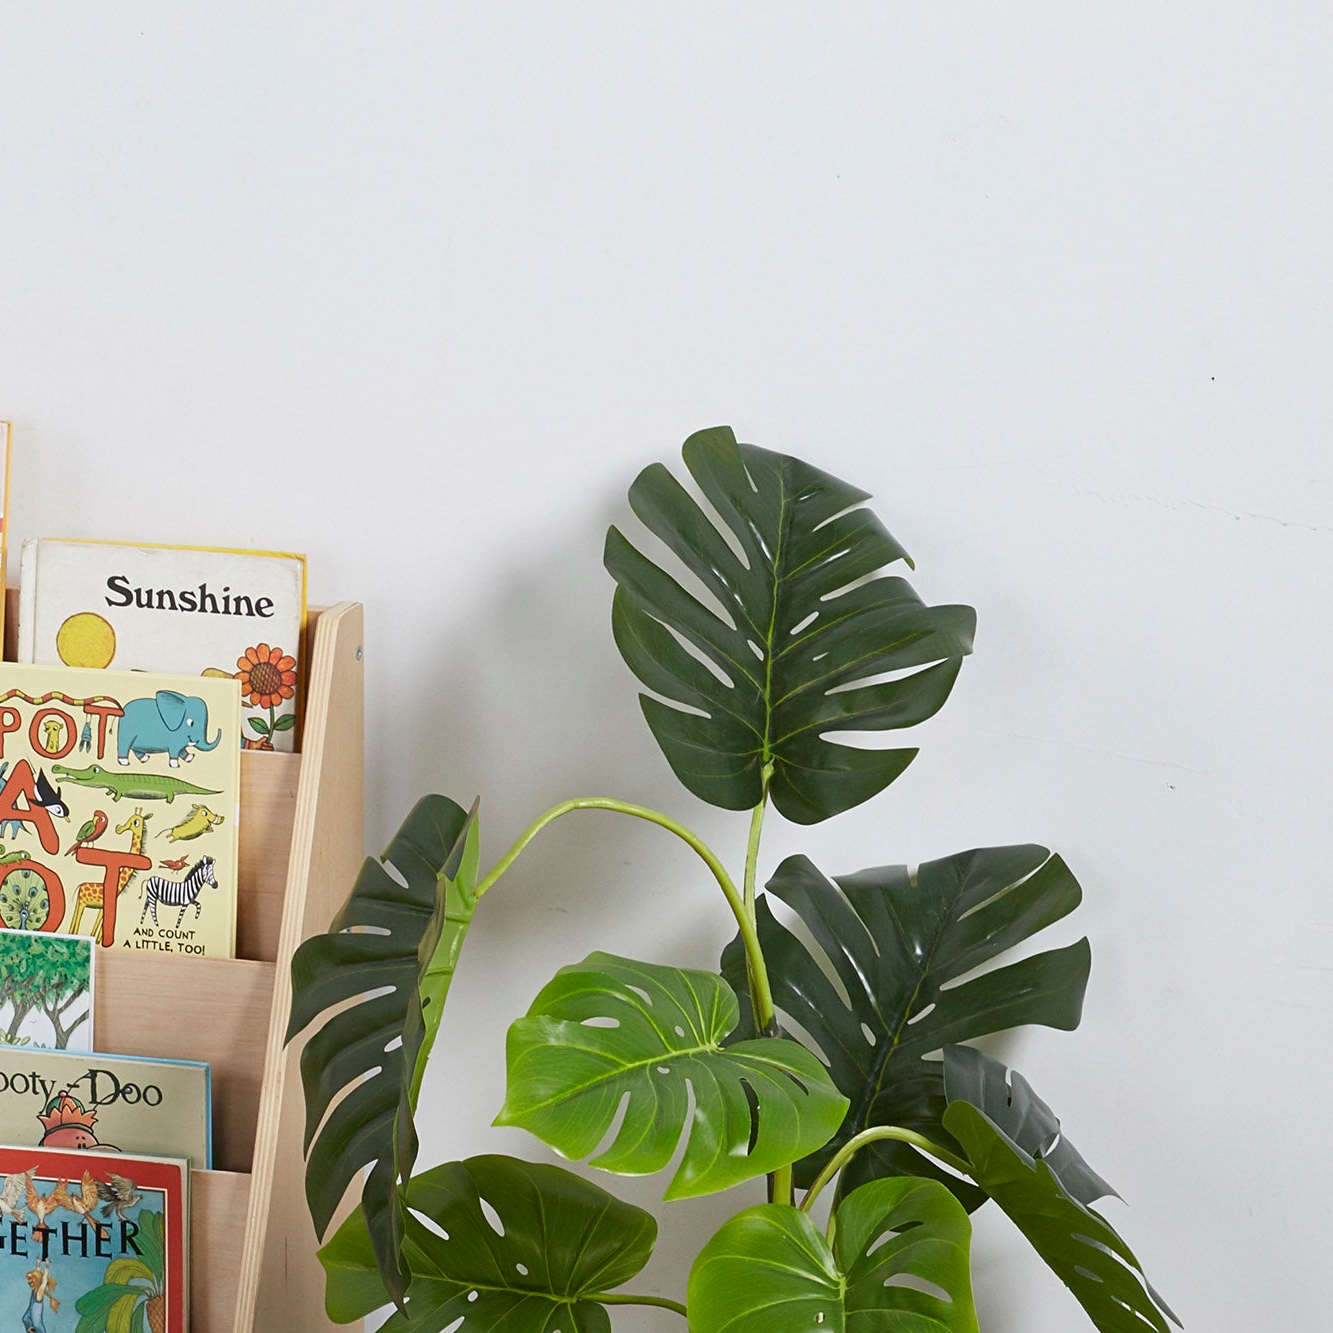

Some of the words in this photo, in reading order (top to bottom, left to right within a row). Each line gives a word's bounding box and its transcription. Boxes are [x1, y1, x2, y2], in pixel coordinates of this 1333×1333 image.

[105, 575, 275, 618] Sunshine
[133, 927, 154, 937] AND
[158, 929, 196, 940] COUNT
[123, 939, 131, 949] A
[135, 940, 173, 952] LITTLE,
[177, 943, 205, 956] TOO!
